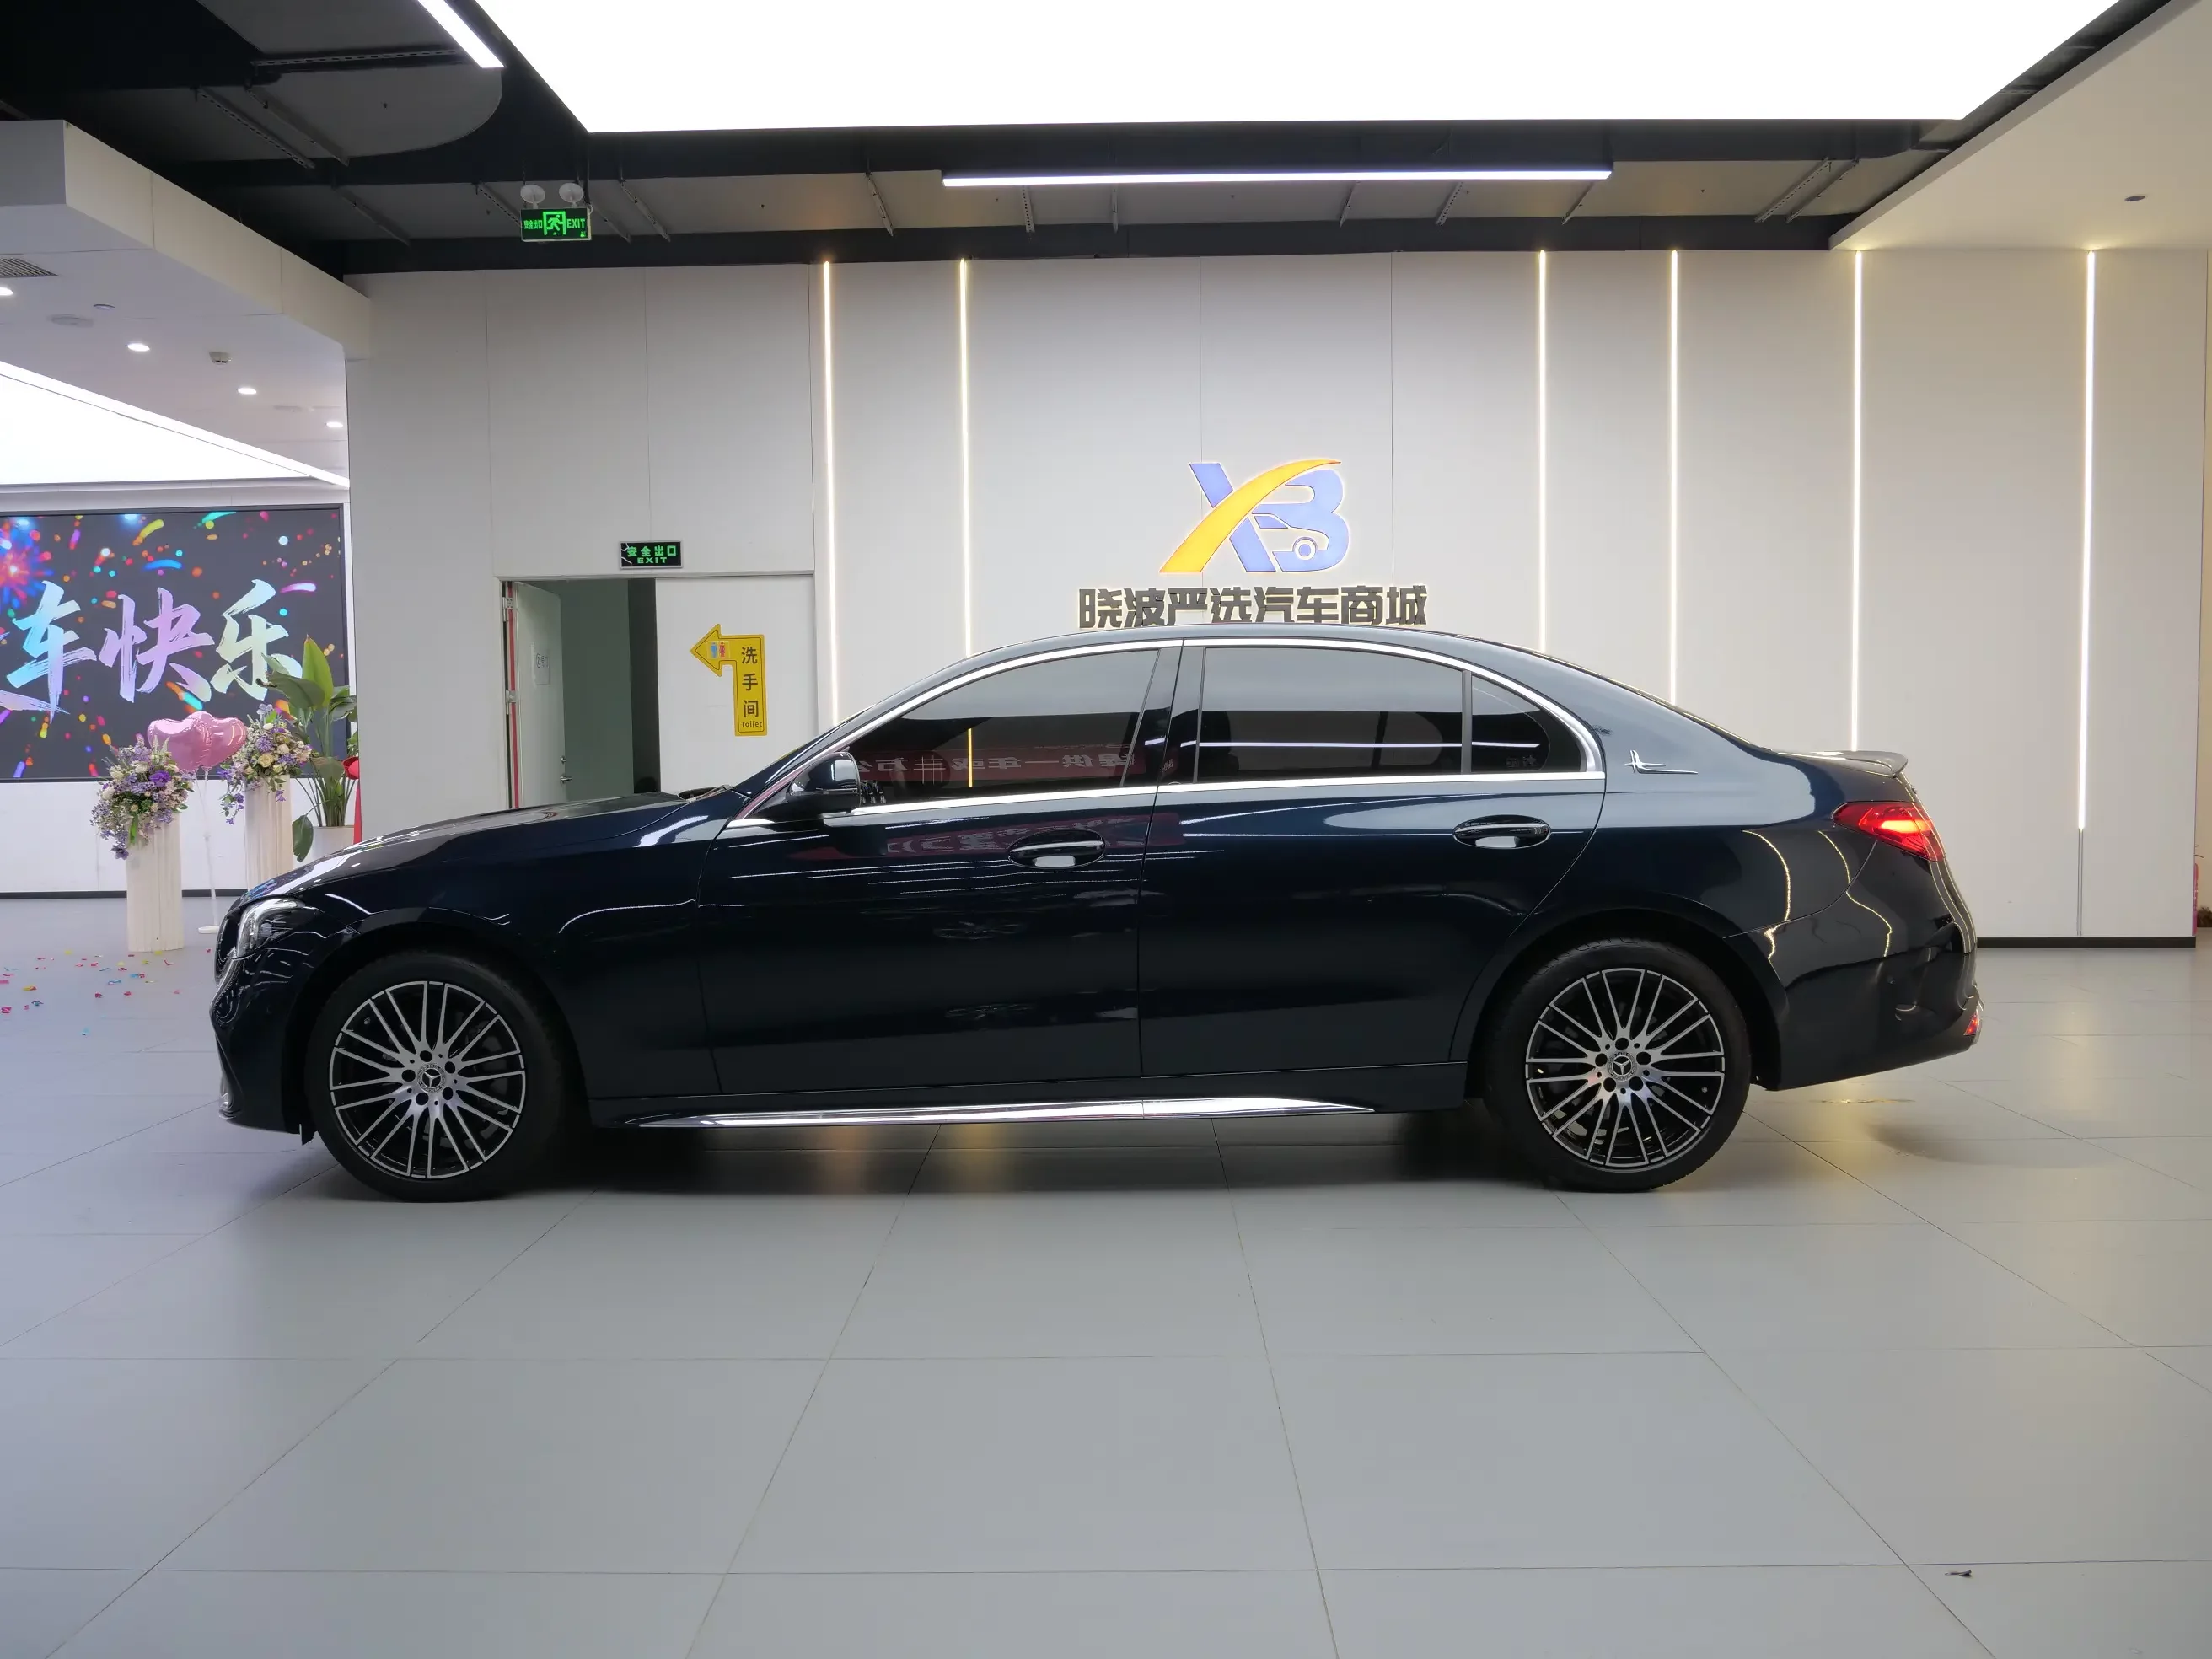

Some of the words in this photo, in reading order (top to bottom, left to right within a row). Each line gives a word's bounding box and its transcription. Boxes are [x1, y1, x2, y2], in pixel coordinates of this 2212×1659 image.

[523, 219, 543, 230] 安全出口
[566, 218, 586, 229] EXIT
[1159, 459, 1349, 573] XB
[626, 545, 677, 557] 安全出口
[1078, 584, 1428, 629] 晓波严选汽车商城
[0, 579, 303, 724] 车快乐
[740, 646, 760, 718] 洗手间
[740, 719, 763, 728] Toilet
